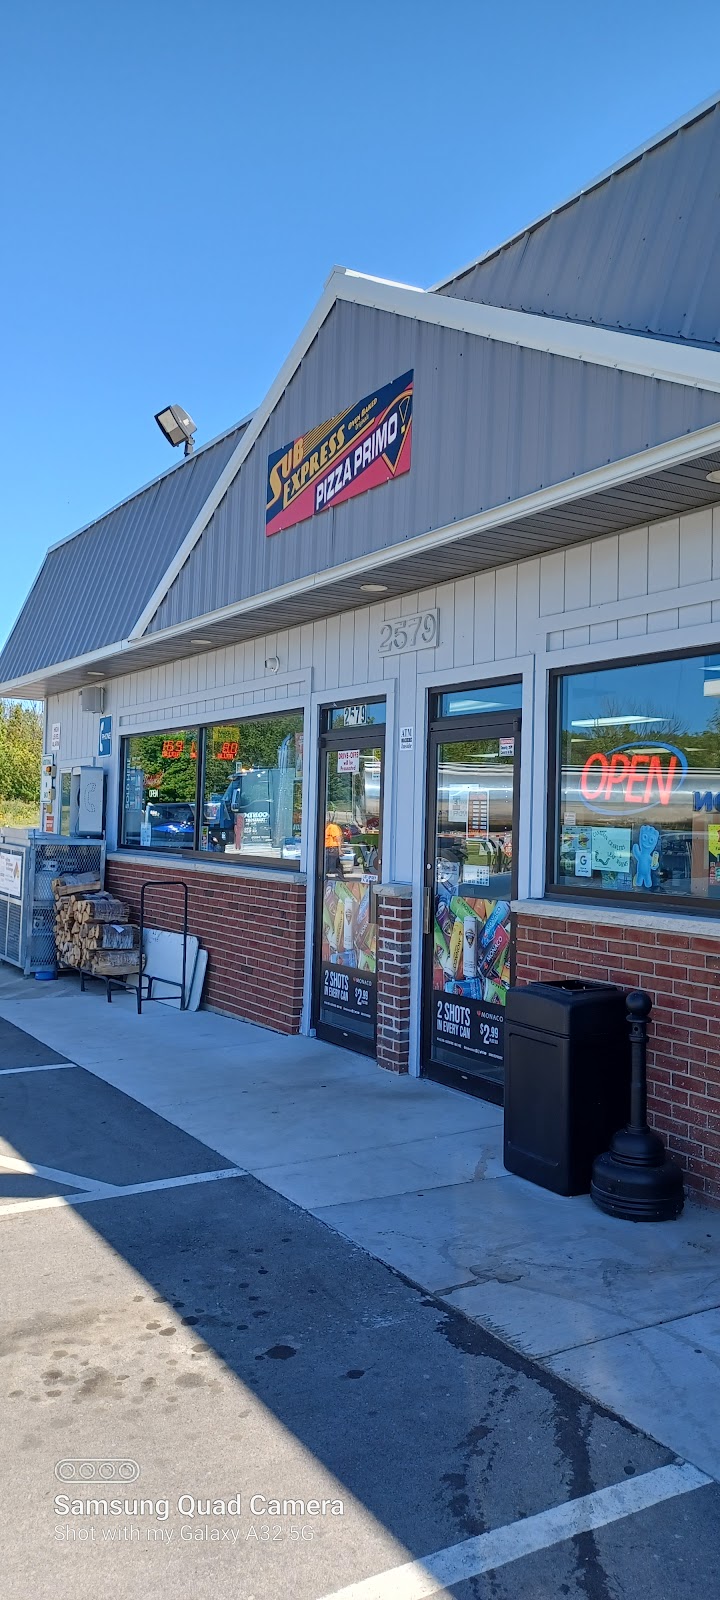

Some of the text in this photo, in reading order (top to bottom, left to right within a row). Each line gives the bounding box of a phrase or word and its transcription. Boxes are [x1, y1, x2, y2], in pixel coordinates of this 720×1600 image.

[283, 424, 345, 511] EXPRESS
[316, 412, 398, 511] PIZZA PRIMO
[266, 437, 304, 510] SUB
[378, 613, 436, 652] 2579
[344, 705, 367, 725] 2579
[401, 728, 412, 737] ATM
[581, 753, 677, 805] OPEN
[580, 855, 588, 866] G
[486, 936, 503, 962] MONACO
[324, 969, 349, 991] 2 SHOTS
[329, 986, 341, 1000] EVERY
[340, 990, 349, 1002] CAN
[437, 1000, 471, 1026] 2 SHOTS
[481, 1011, 504, 1023] MONACO
[436, 1018, 471, 1040] IN EVERY CAN
[480, 1022, 499, 1045] $2.99
